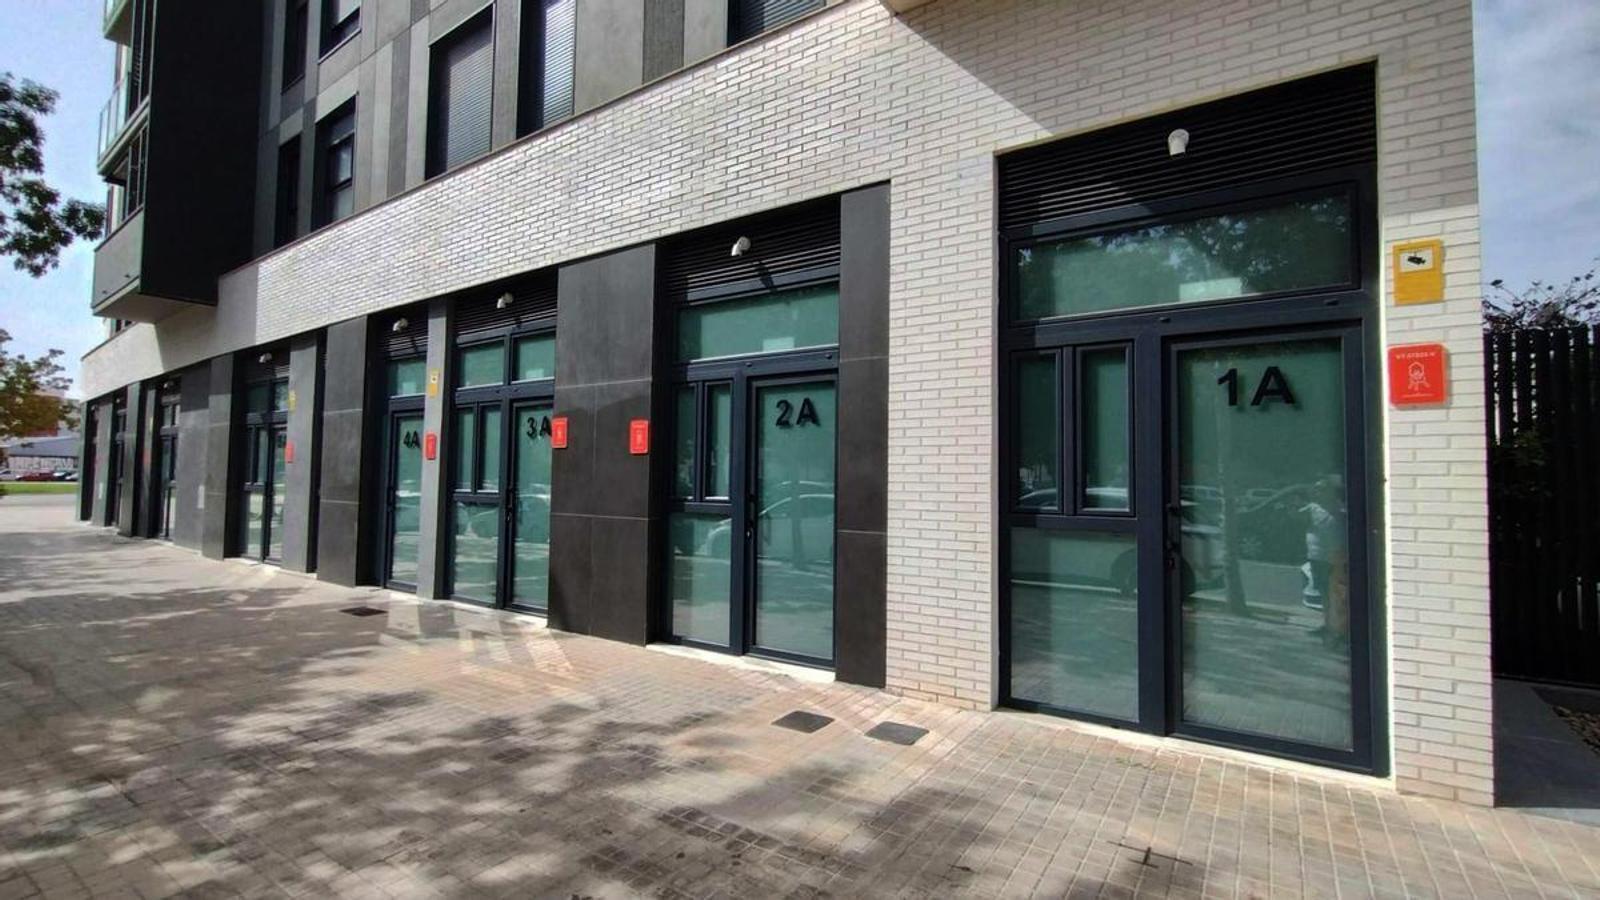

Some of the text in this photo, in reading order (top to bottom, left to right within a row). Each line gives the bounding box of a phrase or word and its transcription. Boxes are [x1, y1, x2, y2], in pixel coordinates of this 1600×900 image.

[1217, 366, 1297, 407] 1A
[776, 398, 821, 427] 2A
[403, 430, 420, 448] 4A
[527, 416, 552, 438] 3A
